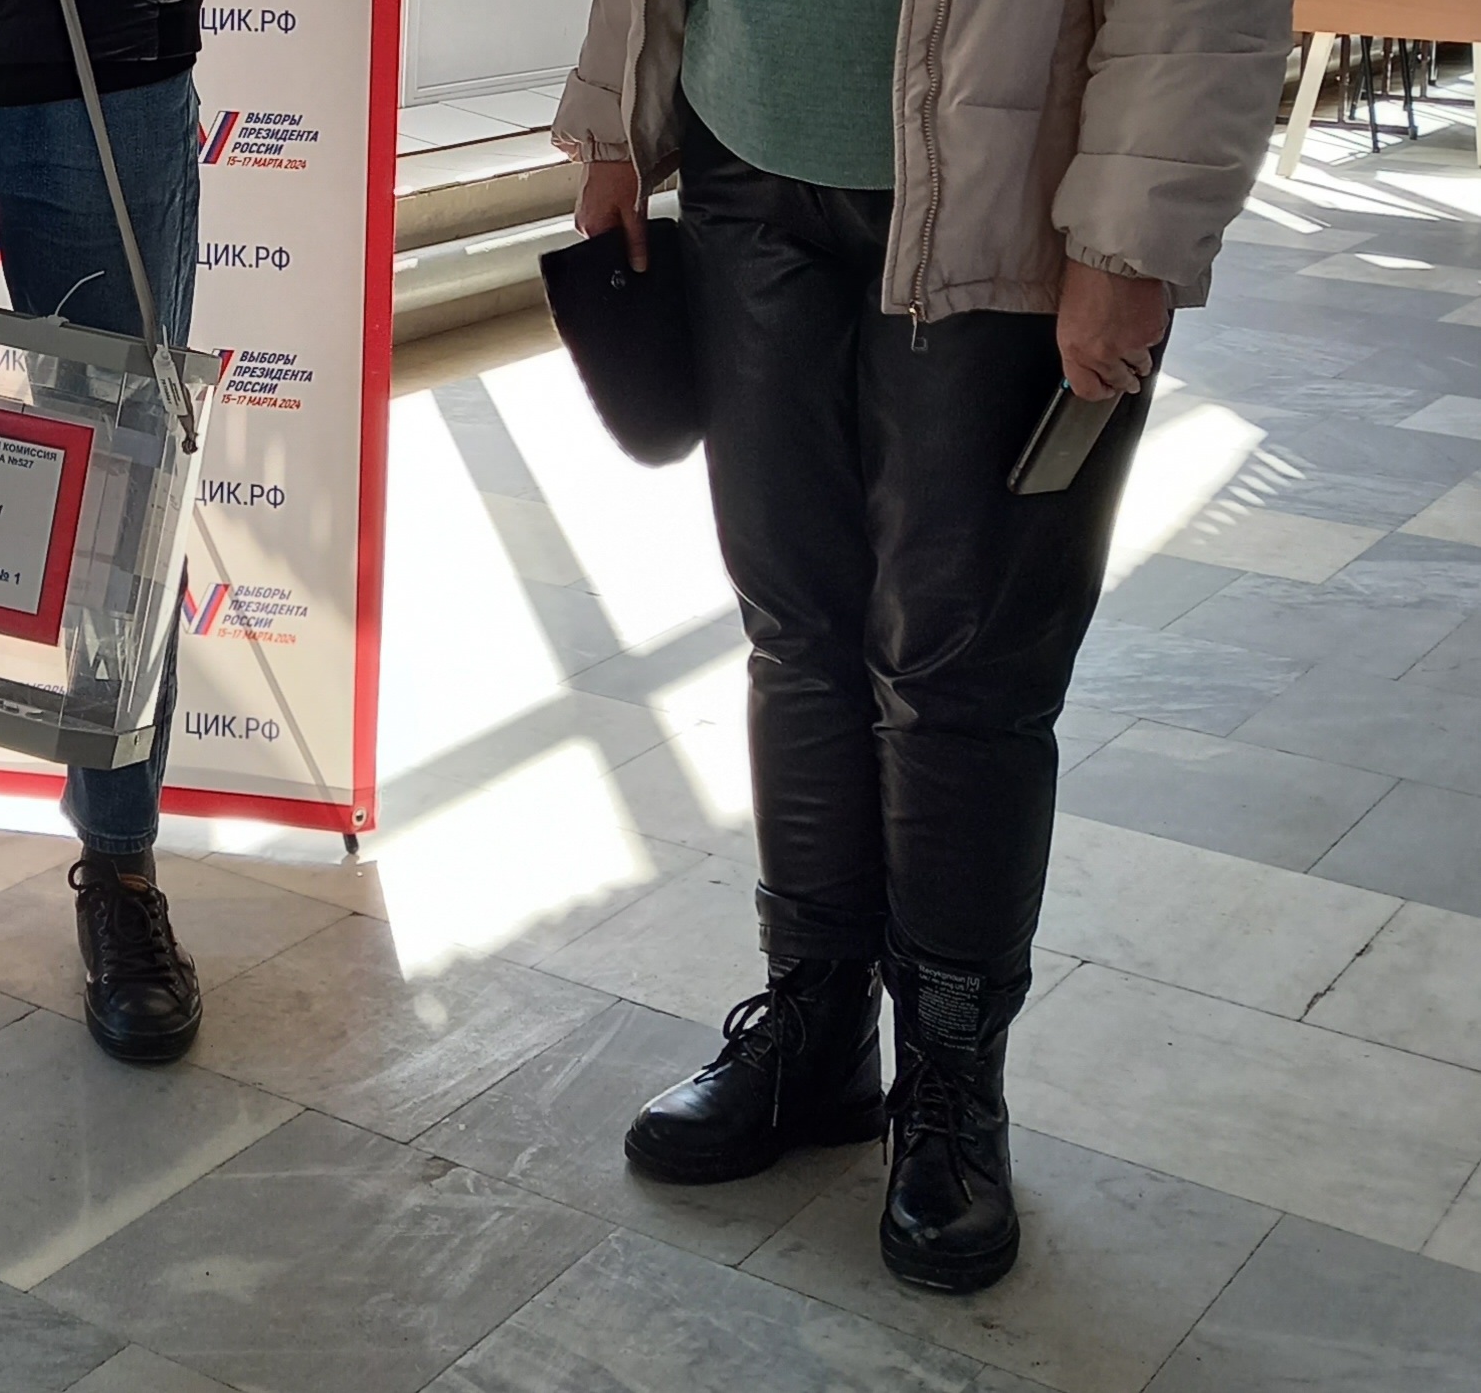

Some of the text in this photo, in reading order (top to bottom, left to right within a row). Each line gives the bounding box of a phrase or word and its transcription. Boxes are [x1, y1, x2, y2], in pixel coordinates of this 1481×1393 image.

[201, 7, 296, 35] ЦИК.РФ
[245, 112, 302, 126] ВЫБОРЫ
[238, 128, 319, 142] ПРЕЗИДЕНТА
[231, 142, 284, 155] РОССИИ
[252, 157, 283, 168] МАРТА
[284, 159, 307, 169] 2024
[196, 243, 290, 271] ЦИК.РФ
[239, 351, 297, 365] ВЫБОРЫ
[233, 366, 313, 382] ПРЕЗИДЕНТА
[226, 380, 278, 394] РОССИИ
[247, 395, 278, 407] МАРТА
[279, 398, 301, 410] 2024
[4, 442, 57, 461] КОМИССИЯ
[13, 572, 21, 586] 1
[235, 585, 292, 600] ВЫБОРЫ
[228, 599, 309, 617] ПРЕЗИДЕНТА
[222, 614, 273, 628] РОССИИ
[243, 629, 273, 643] МАРТА
[274, 633, 297, 645] 2024
[185, 711, 280, 742] ЦИК.РФ
